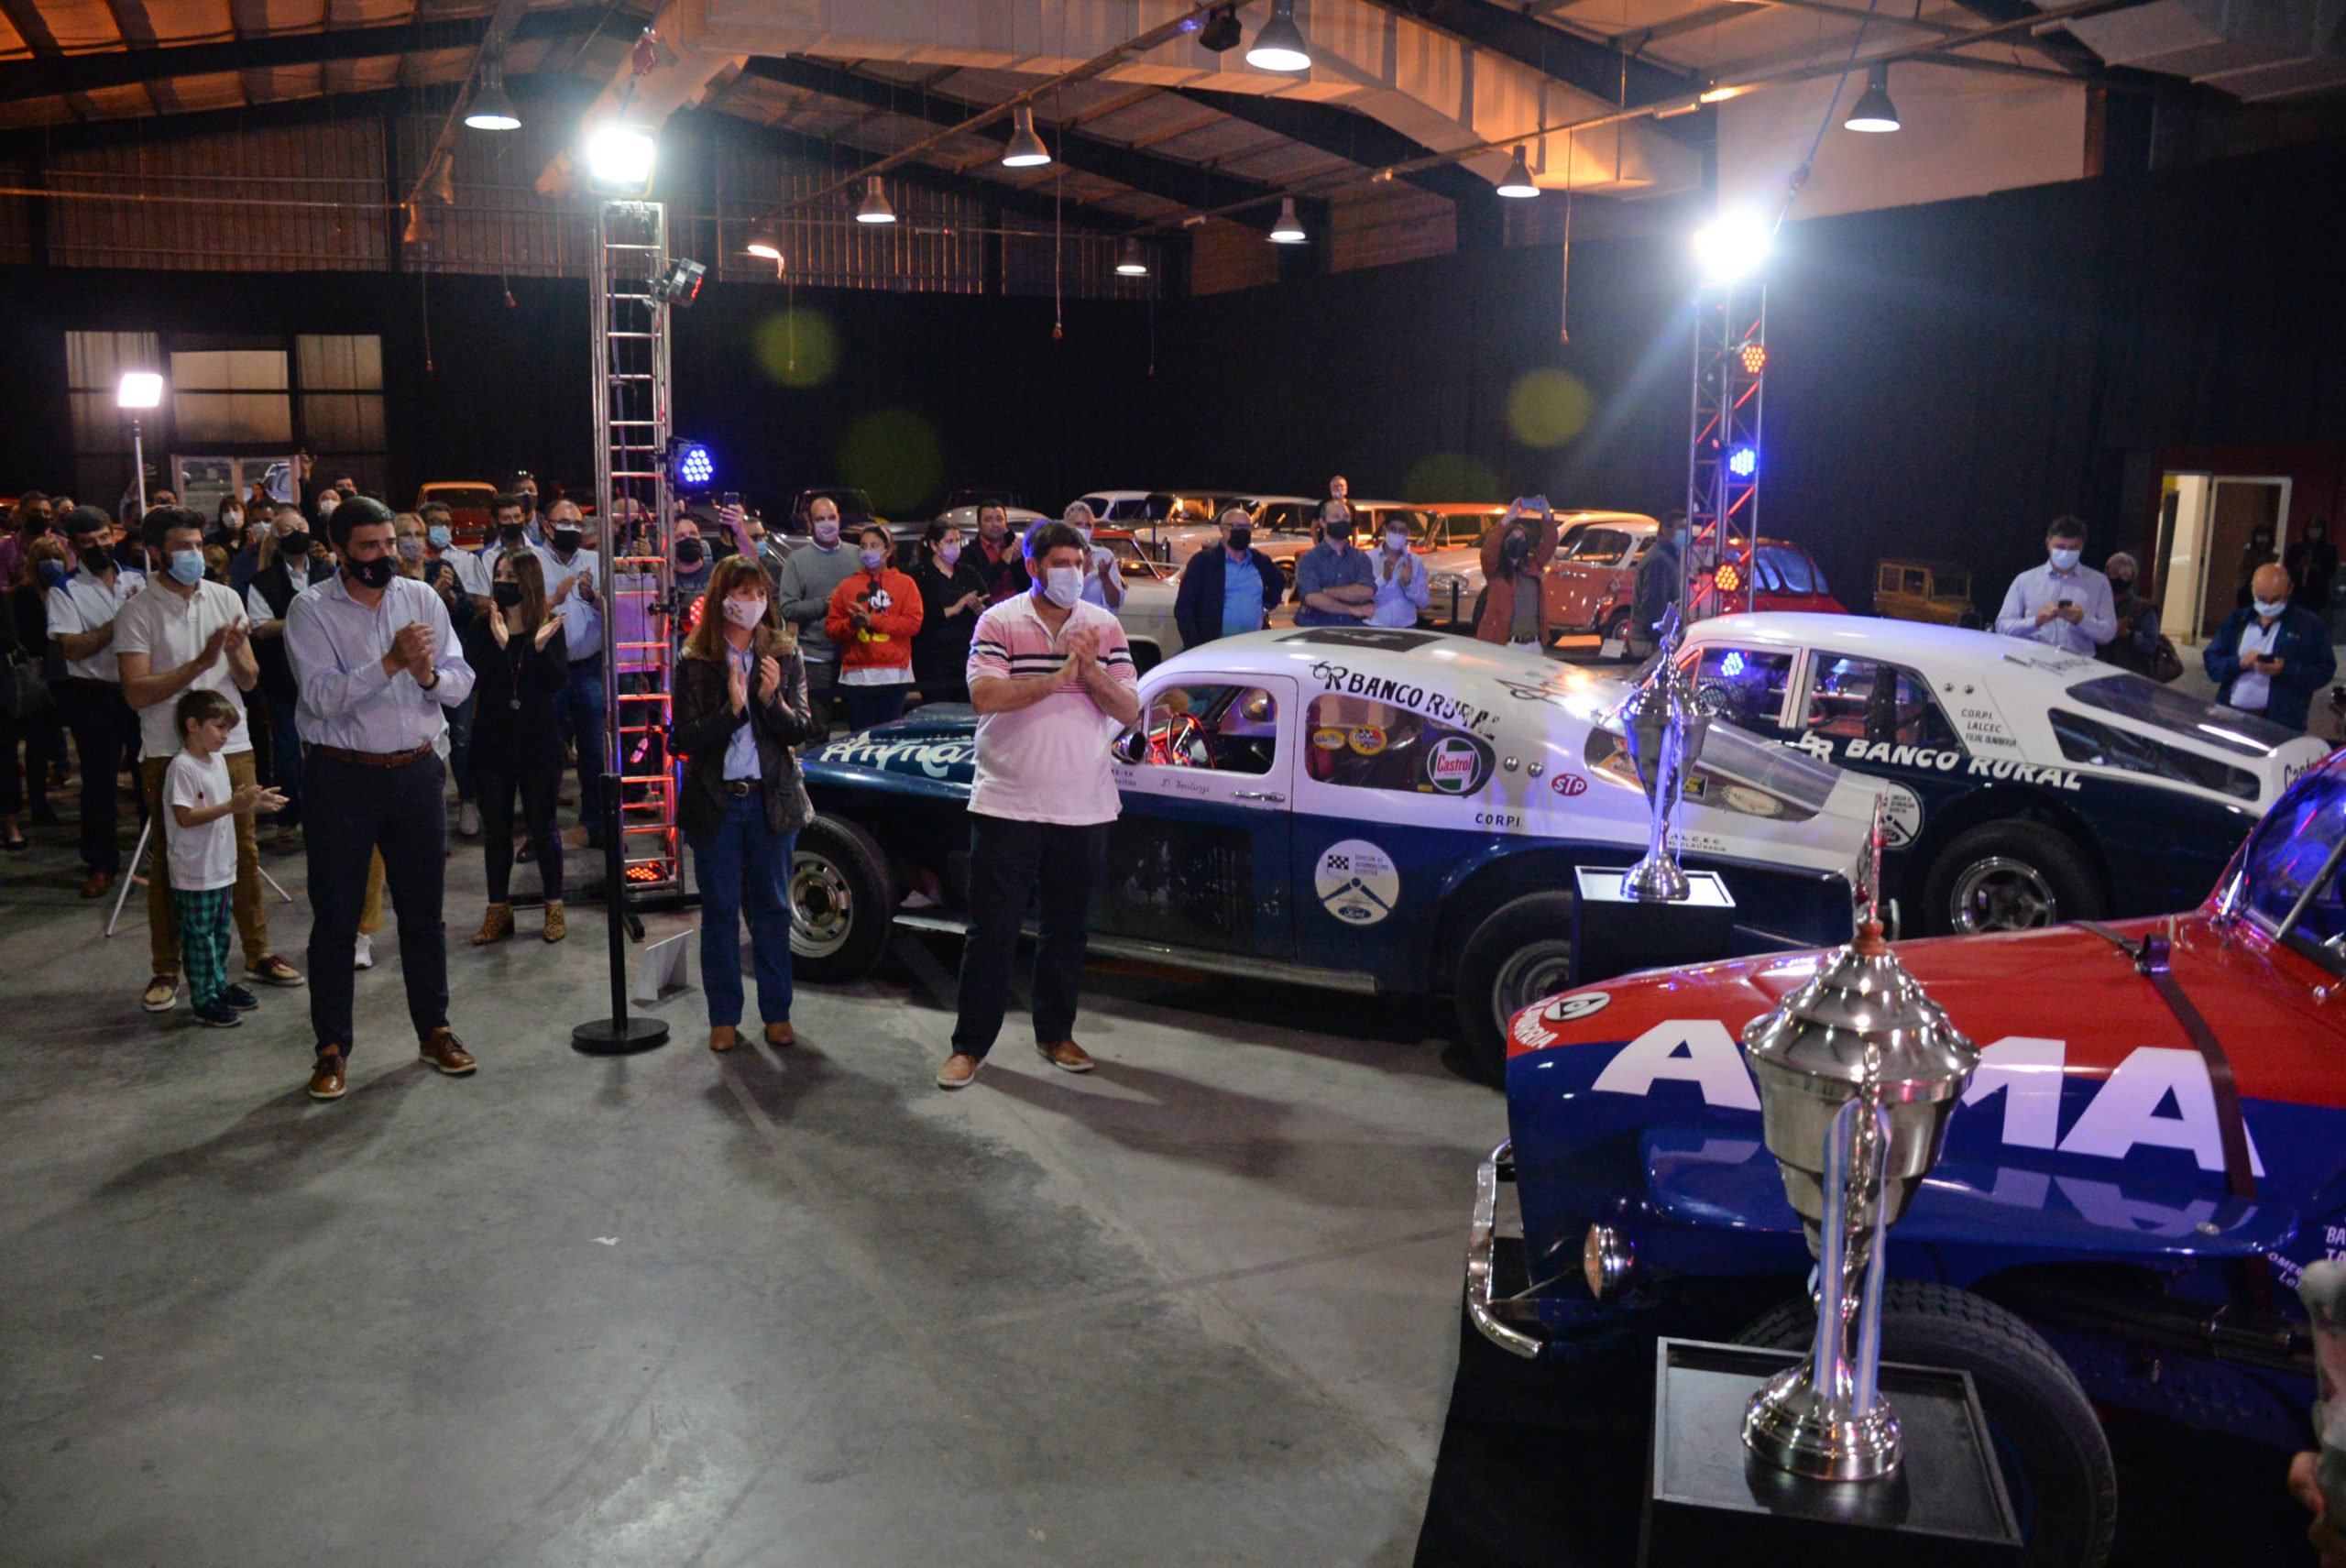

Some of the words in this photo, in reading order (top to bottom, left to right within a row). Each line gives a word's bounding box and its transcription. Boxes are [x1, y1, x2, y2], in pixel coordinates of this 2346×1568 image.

[1347, 673, 1423, 708] BANCO
[1967, 720, 2002, 734] LALCEC
[1436, 753, 1474, 773] Castrol
[1845, 739, 1960, 772] BANCO
[1968, 758, 2082, 791] RURAL
[1554, 775, 1585, 795] STP
[1671, 833, 1721, 845] ALCEC
